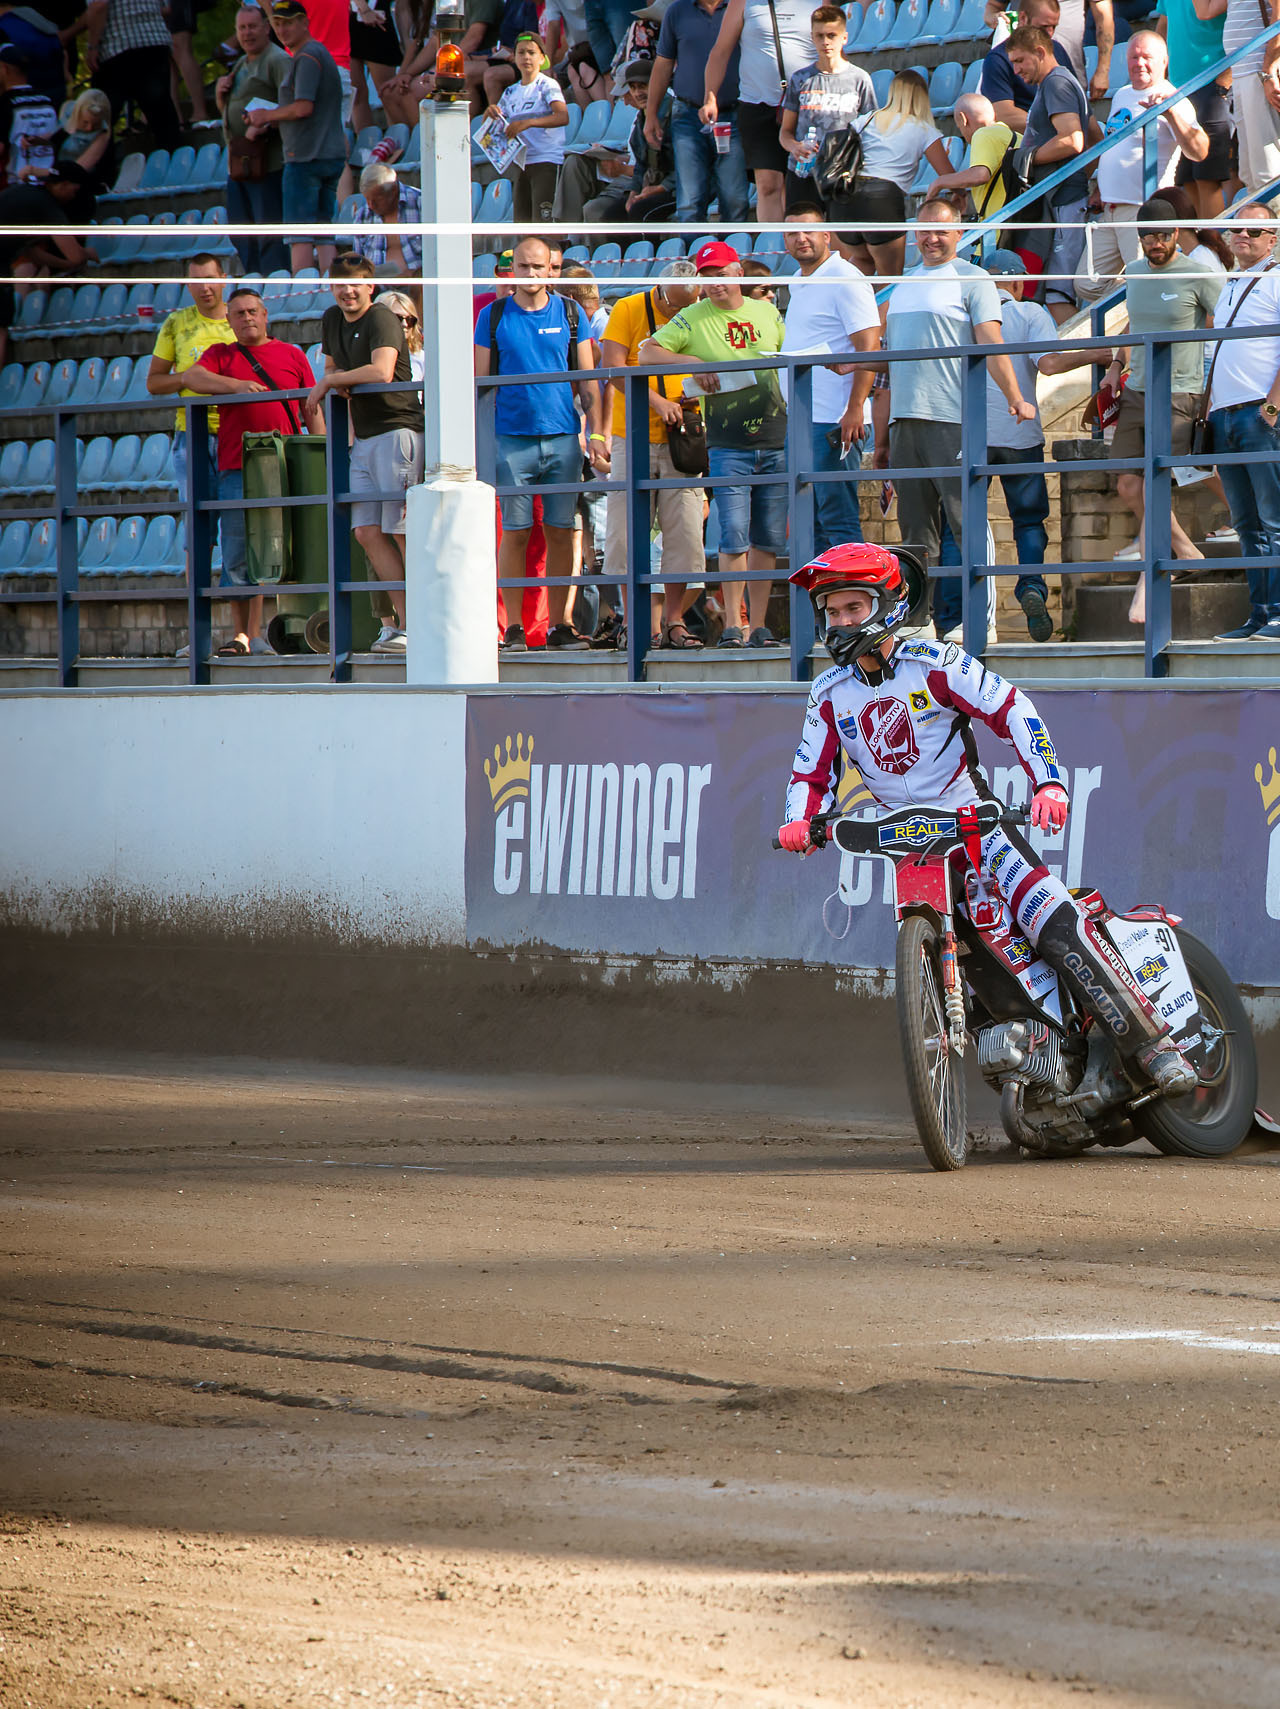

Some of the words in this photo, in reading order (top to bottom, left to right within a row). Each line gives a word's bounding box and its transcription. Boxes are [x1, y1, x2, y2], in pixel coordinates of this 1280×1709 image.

[870, 703, 900, 749] LOKOMOTIV
[1034, 728, 1056, 766] REALL
[895, 823, 943, 839] REALL
[1141, 960, 1164, 980] REALL
[1161, 1002, 1176, 1018] G.B.
[1175, 990, 1193, 1010] AUTO
